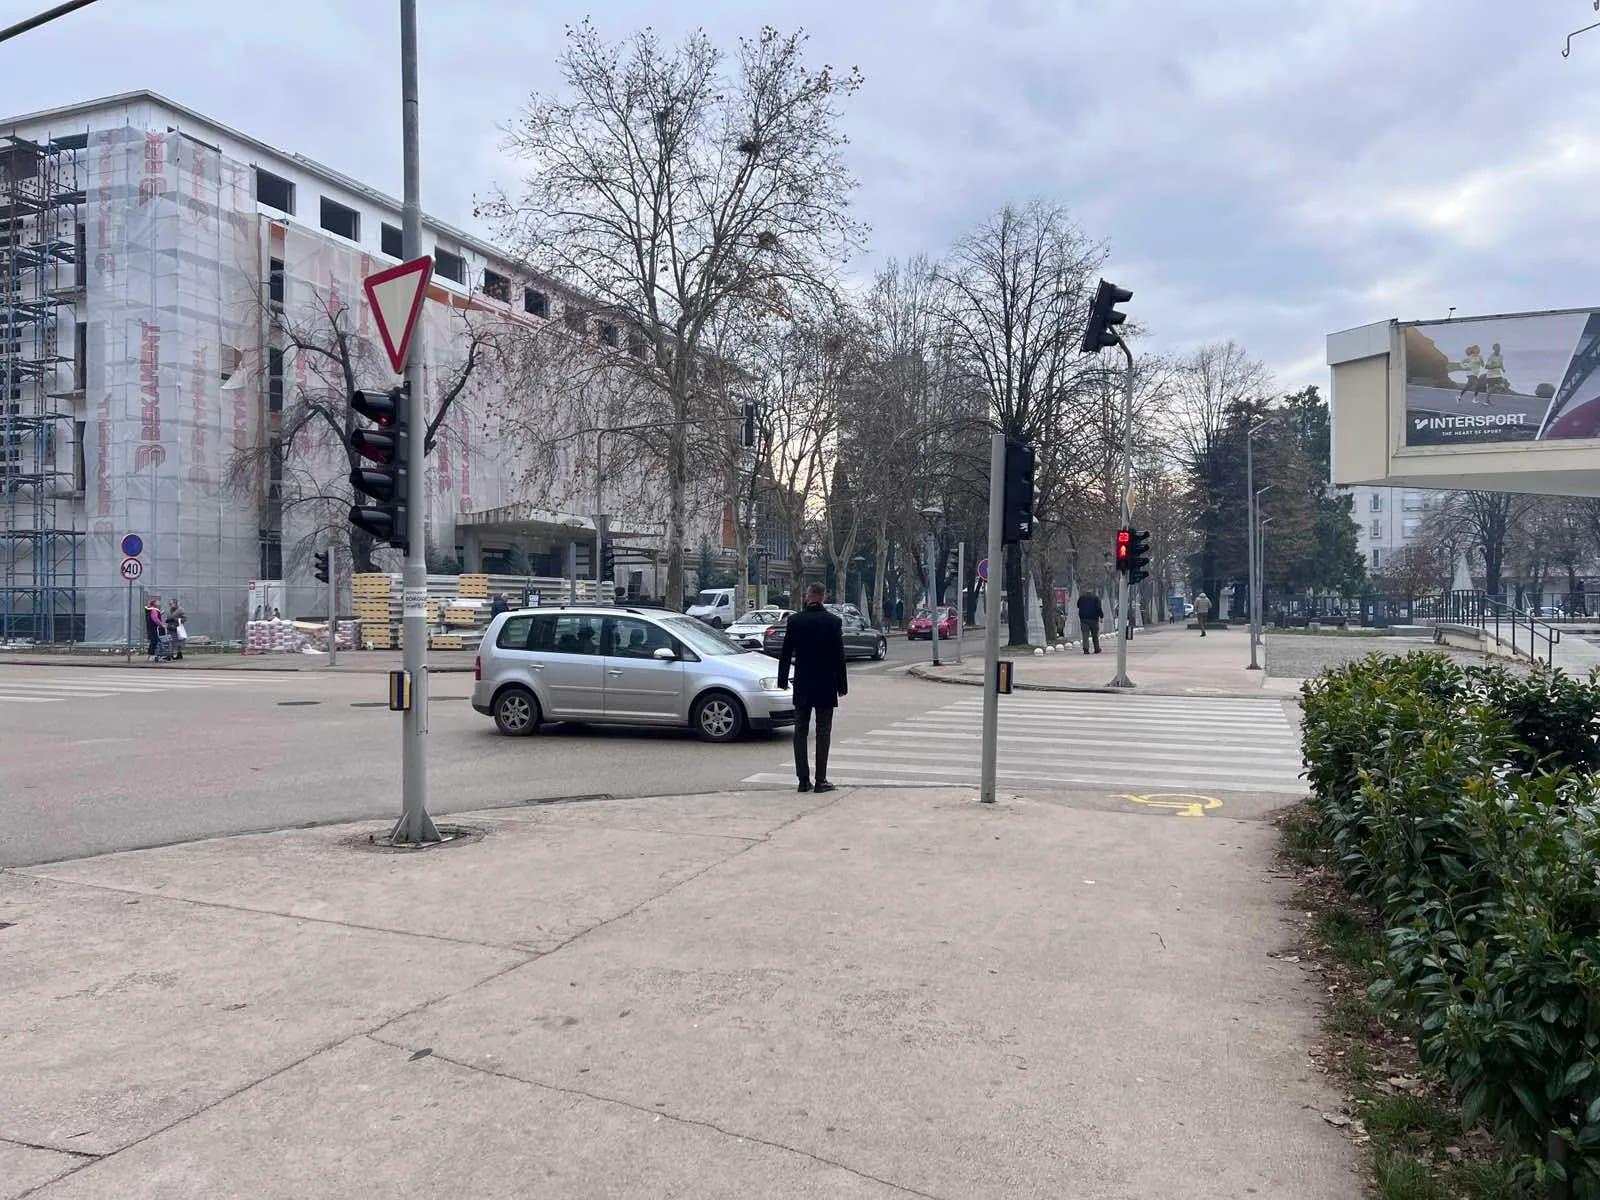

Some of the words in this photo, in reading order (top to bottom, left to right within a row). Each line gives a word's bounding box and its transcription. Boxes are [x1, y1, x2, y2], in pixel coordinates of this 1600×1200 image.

[140, 321, 160, 441] BEKAMENT
[1429, 413, 1527, 429] INTERSPORT
[125, 563, 138, 575] 40
